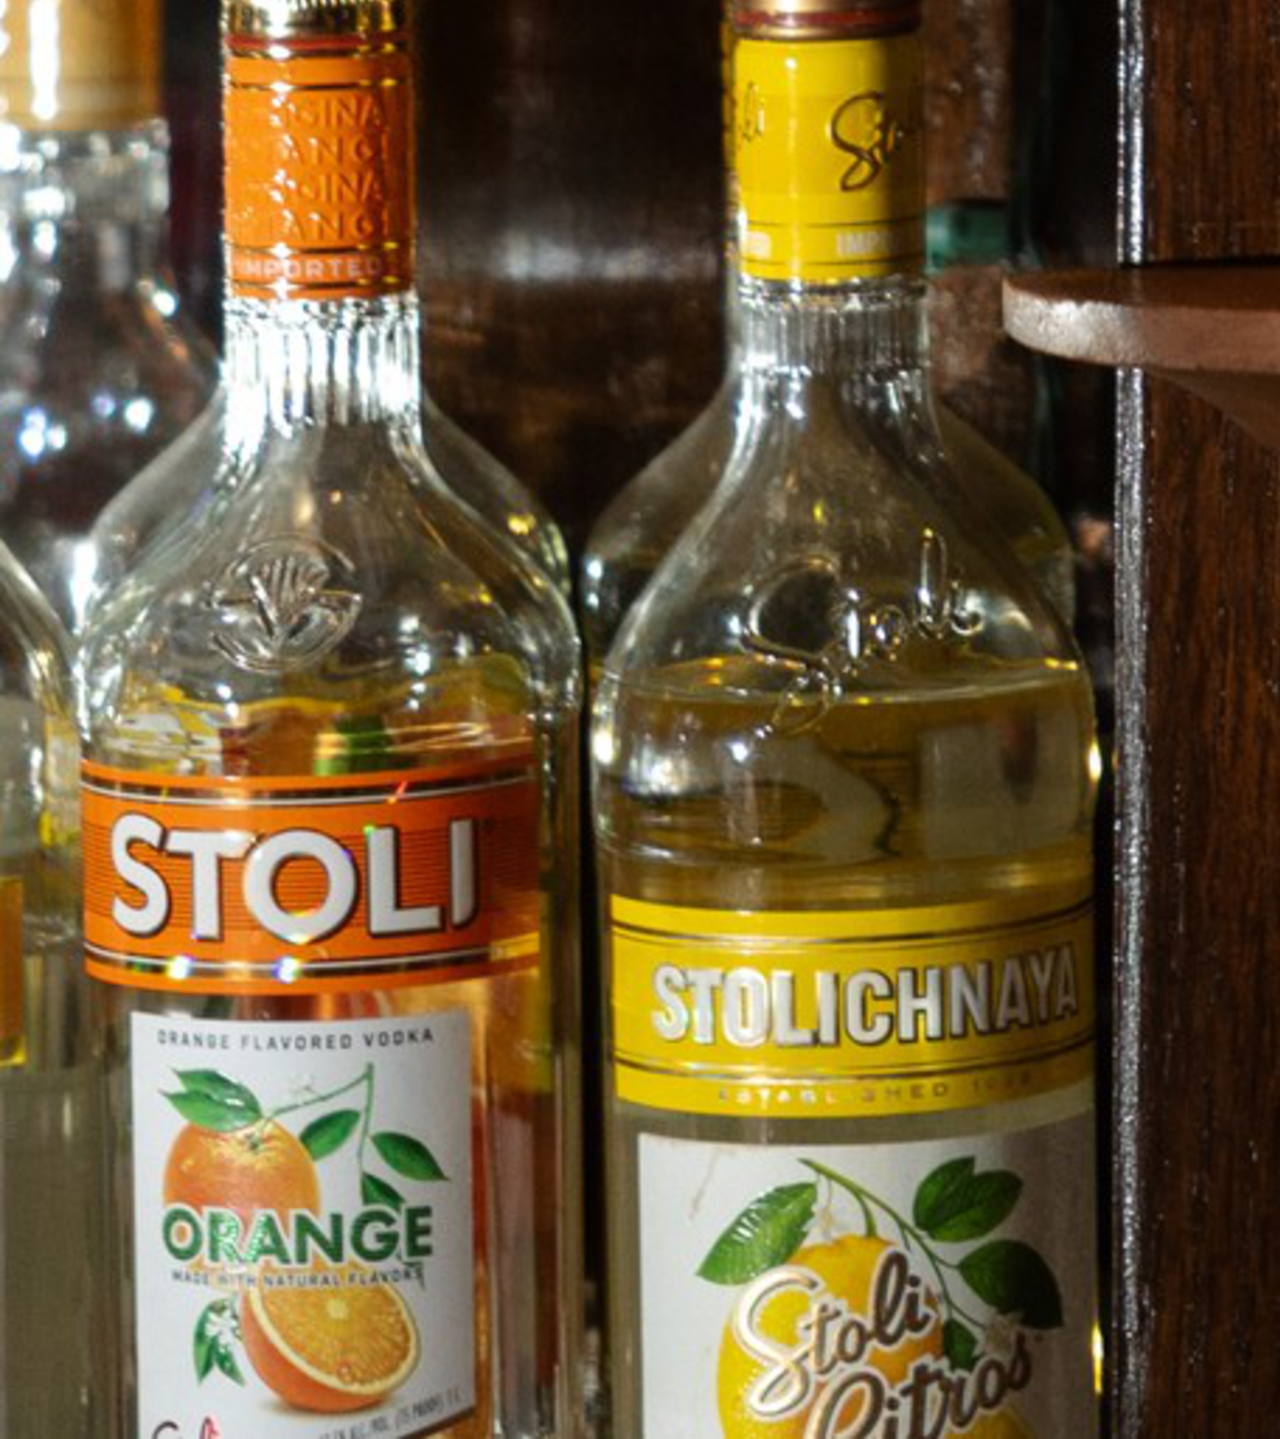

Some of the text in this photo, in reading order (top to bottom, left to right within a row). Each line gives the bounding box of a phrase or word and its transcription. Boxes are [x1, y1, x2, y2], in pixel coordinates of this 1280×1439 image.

[108, 812, 480, 944] STOLI
[649, 940, 1080, 1049] STOLICHNAYA
[157, 1027, 435, 1051] ORANGE FLAVORED VODKA
[162, 1205, 435, 1264] ORANGE
[263, 1271, 341, 1288] NATURAL
[732, 1250, 932, 1420] Stoli
